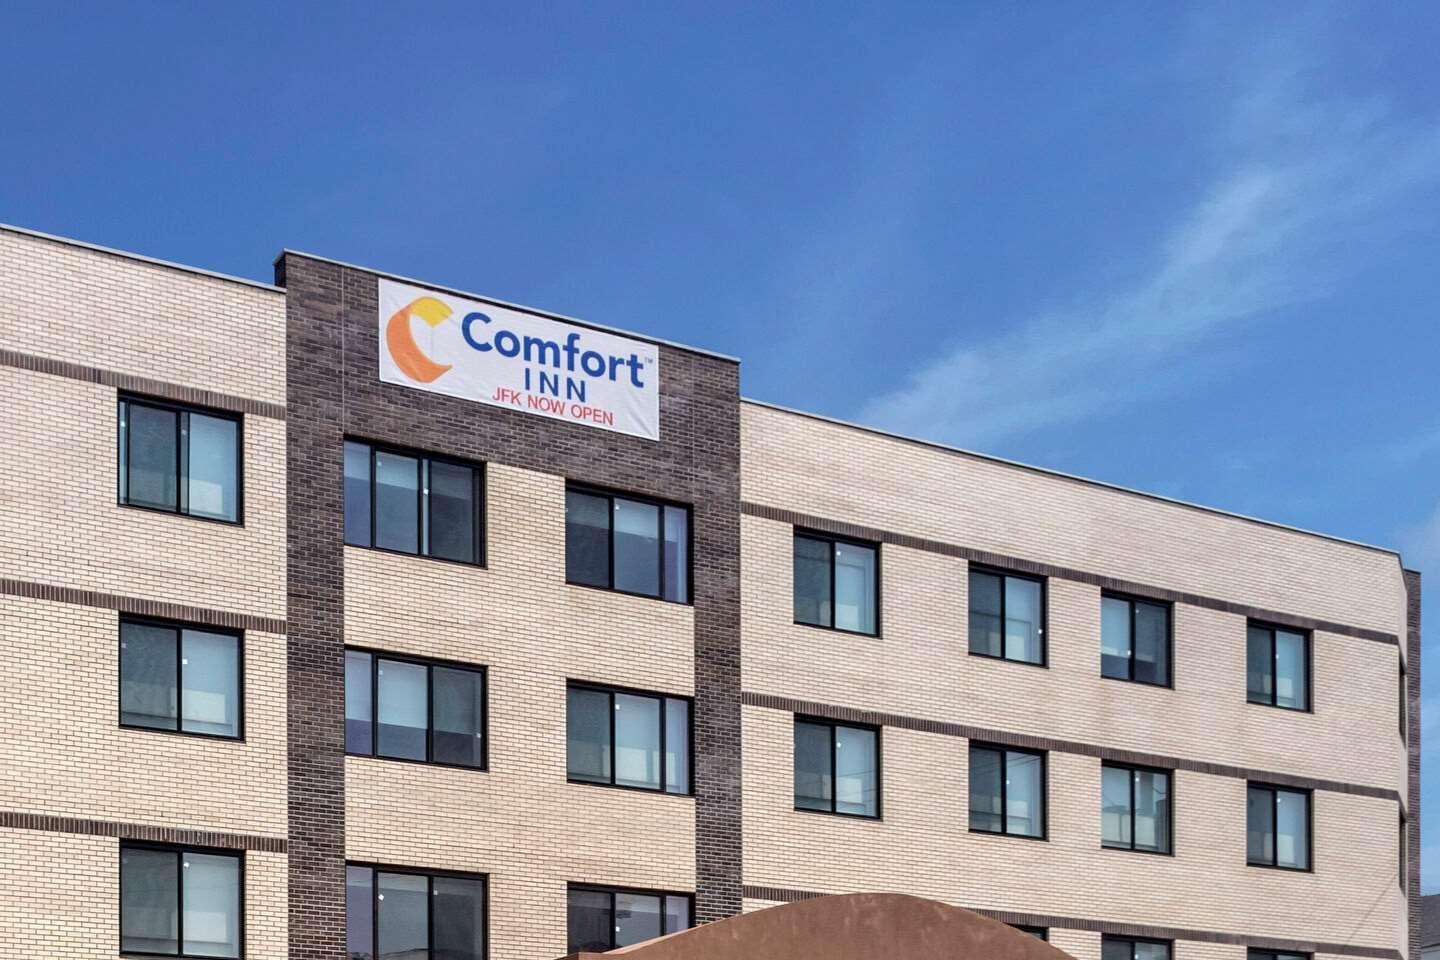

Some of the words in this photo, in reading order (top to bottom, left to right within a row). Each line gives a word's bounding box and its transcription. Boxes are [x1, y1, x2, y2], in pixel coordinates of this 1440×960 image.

[461, 312, 644, 388] Comfort
[525, 368, 586, 402] INN
[492, 387, 522, 406] JFK
[527, 395, 566, 416] NOW
[570, 404, 614, 425] OPEN
